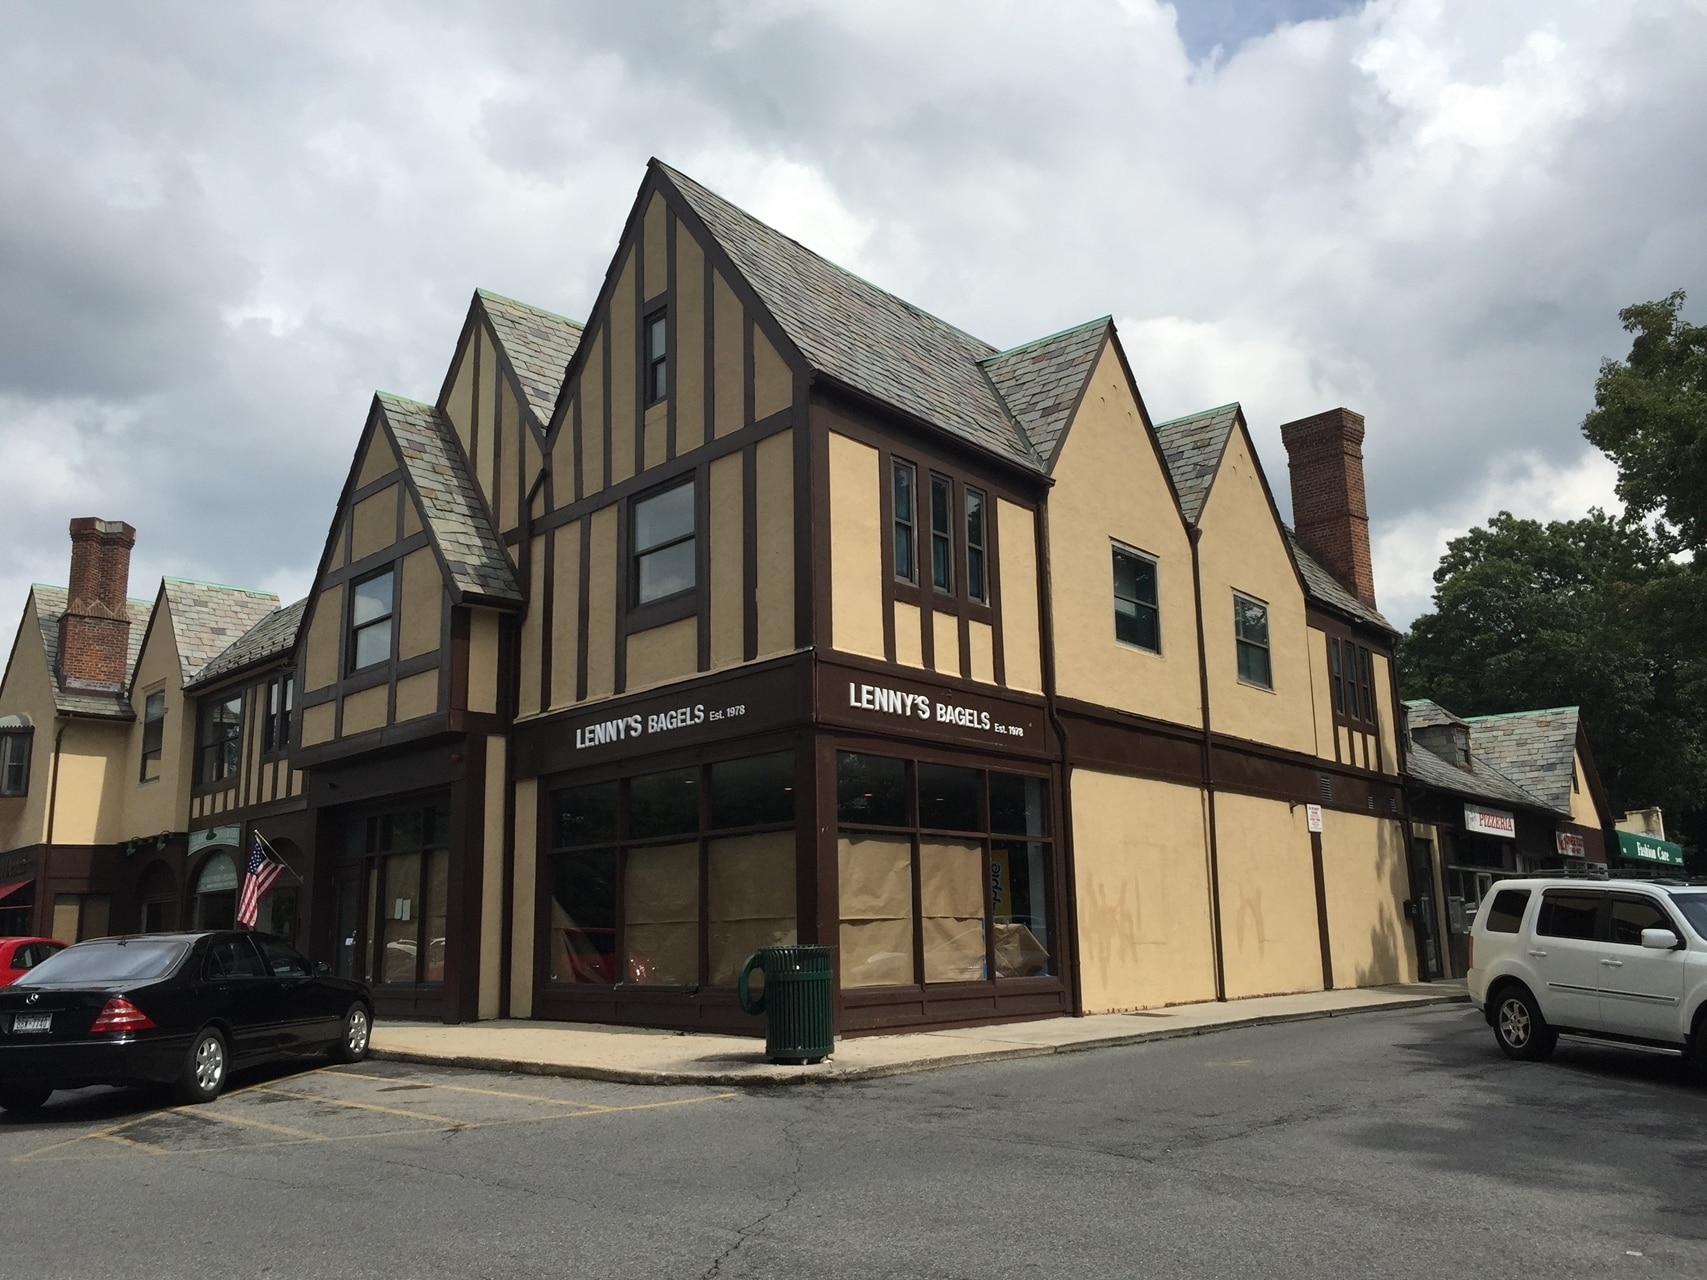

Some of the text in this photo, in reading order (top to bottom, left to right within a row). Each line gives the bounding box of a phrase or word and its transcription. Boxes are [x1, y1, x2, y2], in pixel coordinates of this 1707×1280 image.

[849, 682, 1024, 737] LENNY'S BAGELS Est. 1978
[576, 704, 746, 749] LENNY'S BAGELS Est. 1978
[1478, 812, 1513, 832] PIZZERIA
[1636, 841, 1670, 862] Fashion Care
